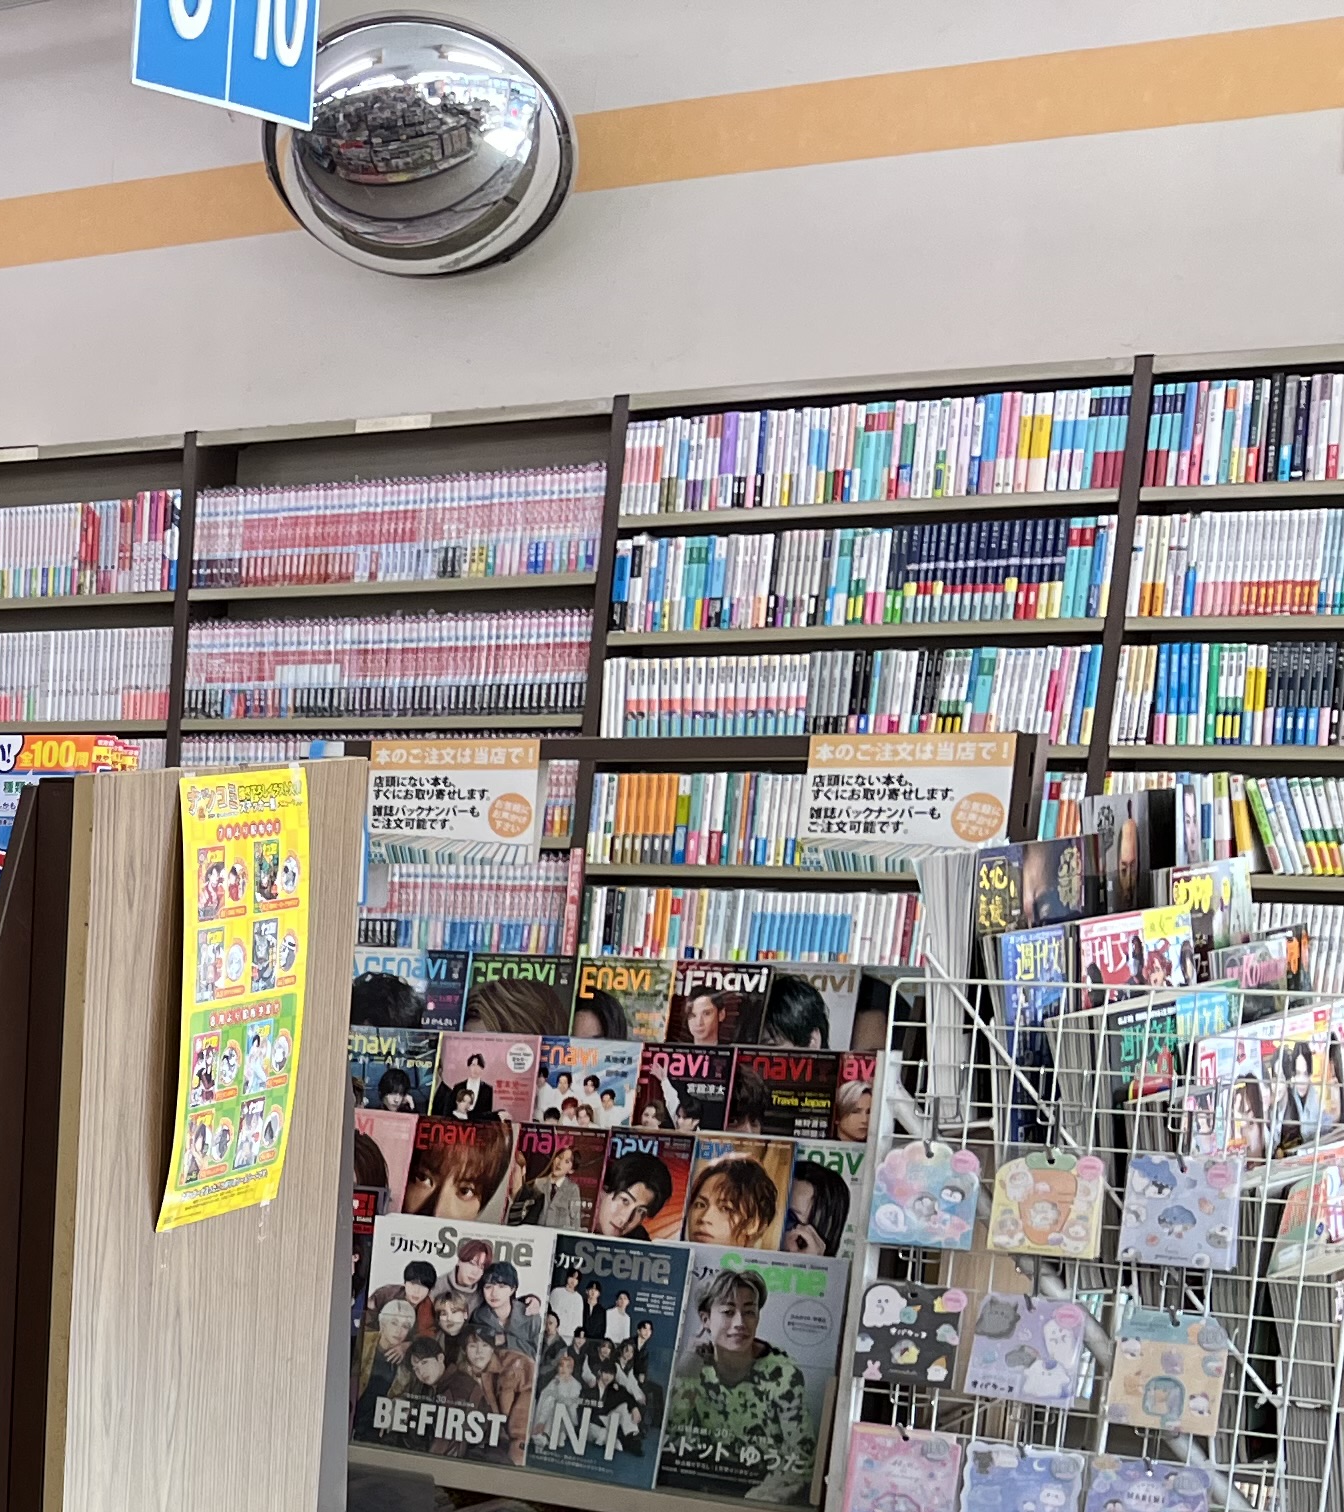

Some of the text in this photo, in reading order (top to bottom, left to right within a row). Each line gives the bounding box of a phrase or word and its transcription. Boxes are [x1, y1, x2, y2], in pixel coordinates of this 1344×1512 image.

[20, 740, 90, 768] 全100問
[376, 747, 534, 765] 本のご注文は当店で！
[816, 742, 1009, 761] 本のご注文は当店で！
[374, 776, 456, 788] 店頭にない本も、
[813, 774, 913, 787] 店頭にない本も、
[373, 788, 490, 800] すぐにお取り寄せします。
[812, 788, 954, 801] すぐにお取り寄せします。
[372, 806, 480, 817] 雑誌バックナンバーも
[810, 807, 941, 820] 雑誌バックナンバーも
[371, 818, 454, 830] ご注文可能です。
[808, 821, 909, 834] ご注文可能です。
[576, 1240, 671, 1285] Scene
[374, 1396, 507, 1448] BE:FIRST
[738, 1447, 805, 1475] ゆうた
